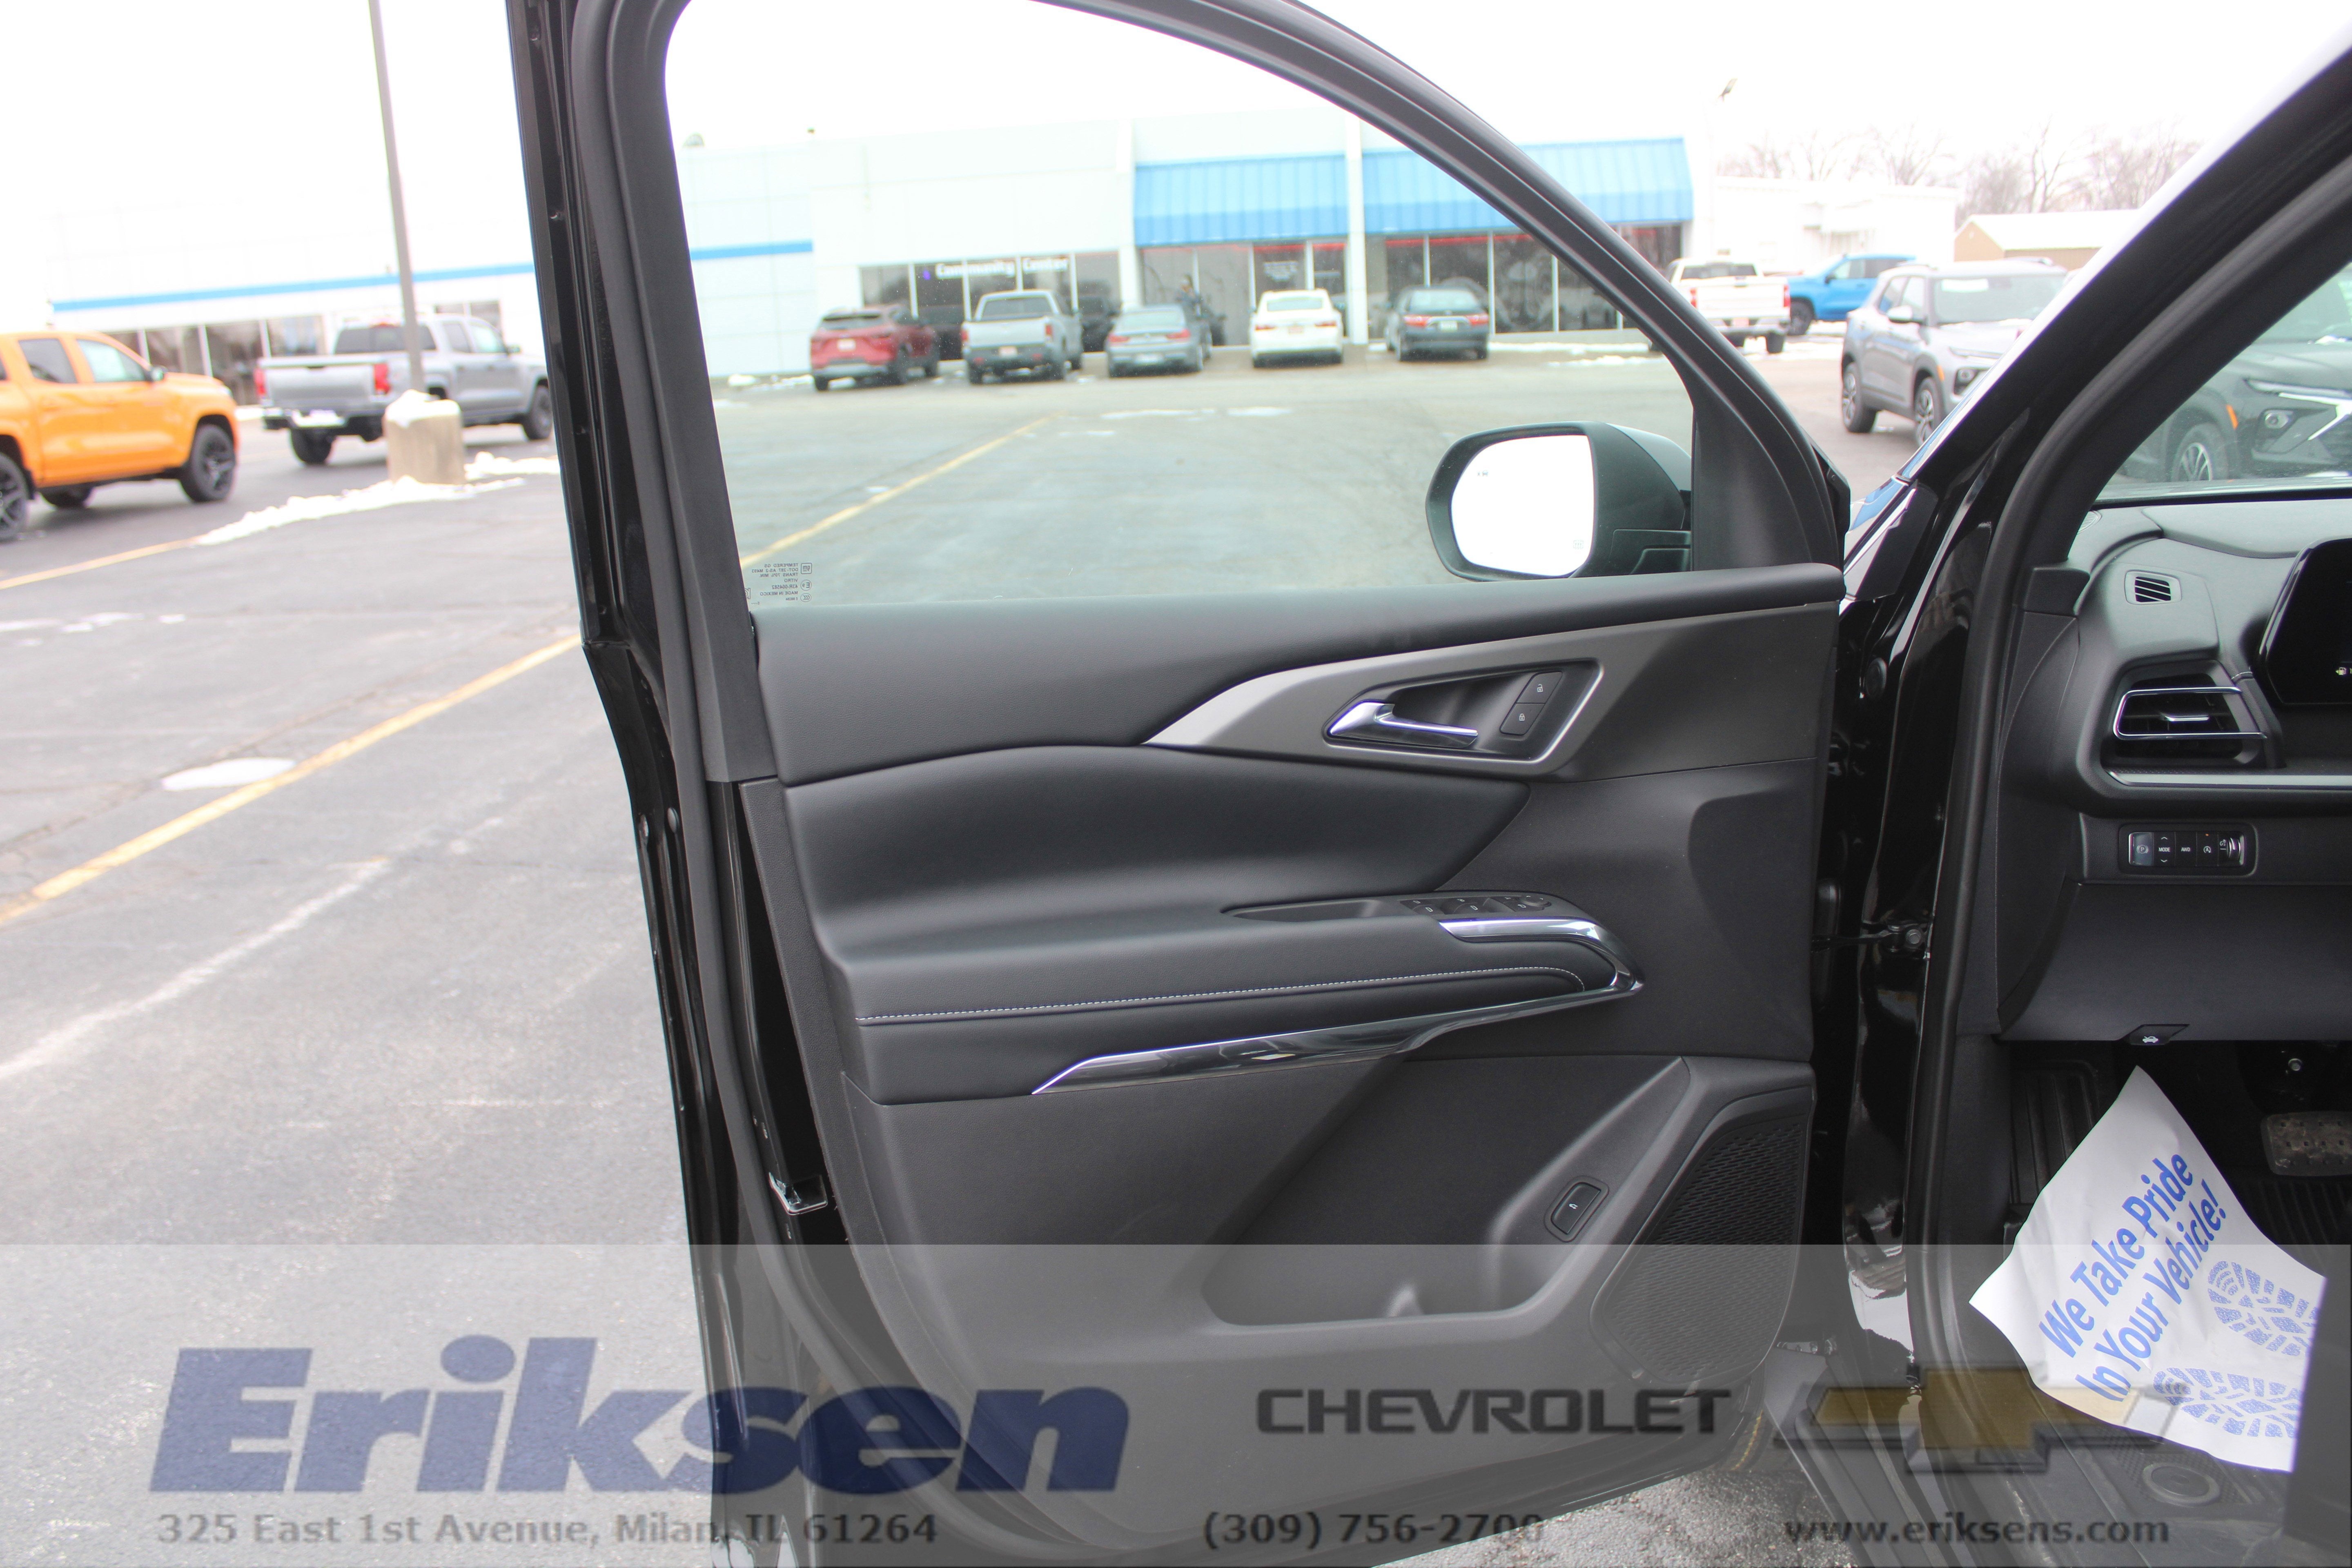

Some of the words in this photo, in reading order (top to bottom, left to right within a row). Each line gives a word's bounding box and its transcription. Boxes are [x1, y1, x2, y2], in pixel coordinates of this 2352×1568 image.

[2038, 1298, 2094, 1358] We
[2069, 1239, 2145, 1307] Take
[2121, 1154, 2193, 1239] Pride
[2142, 1178, 2226, 1305] Vehicle!
[2075, 1365, 2132, 1402] In
[2093, 1292, 2169, 1372] Your
